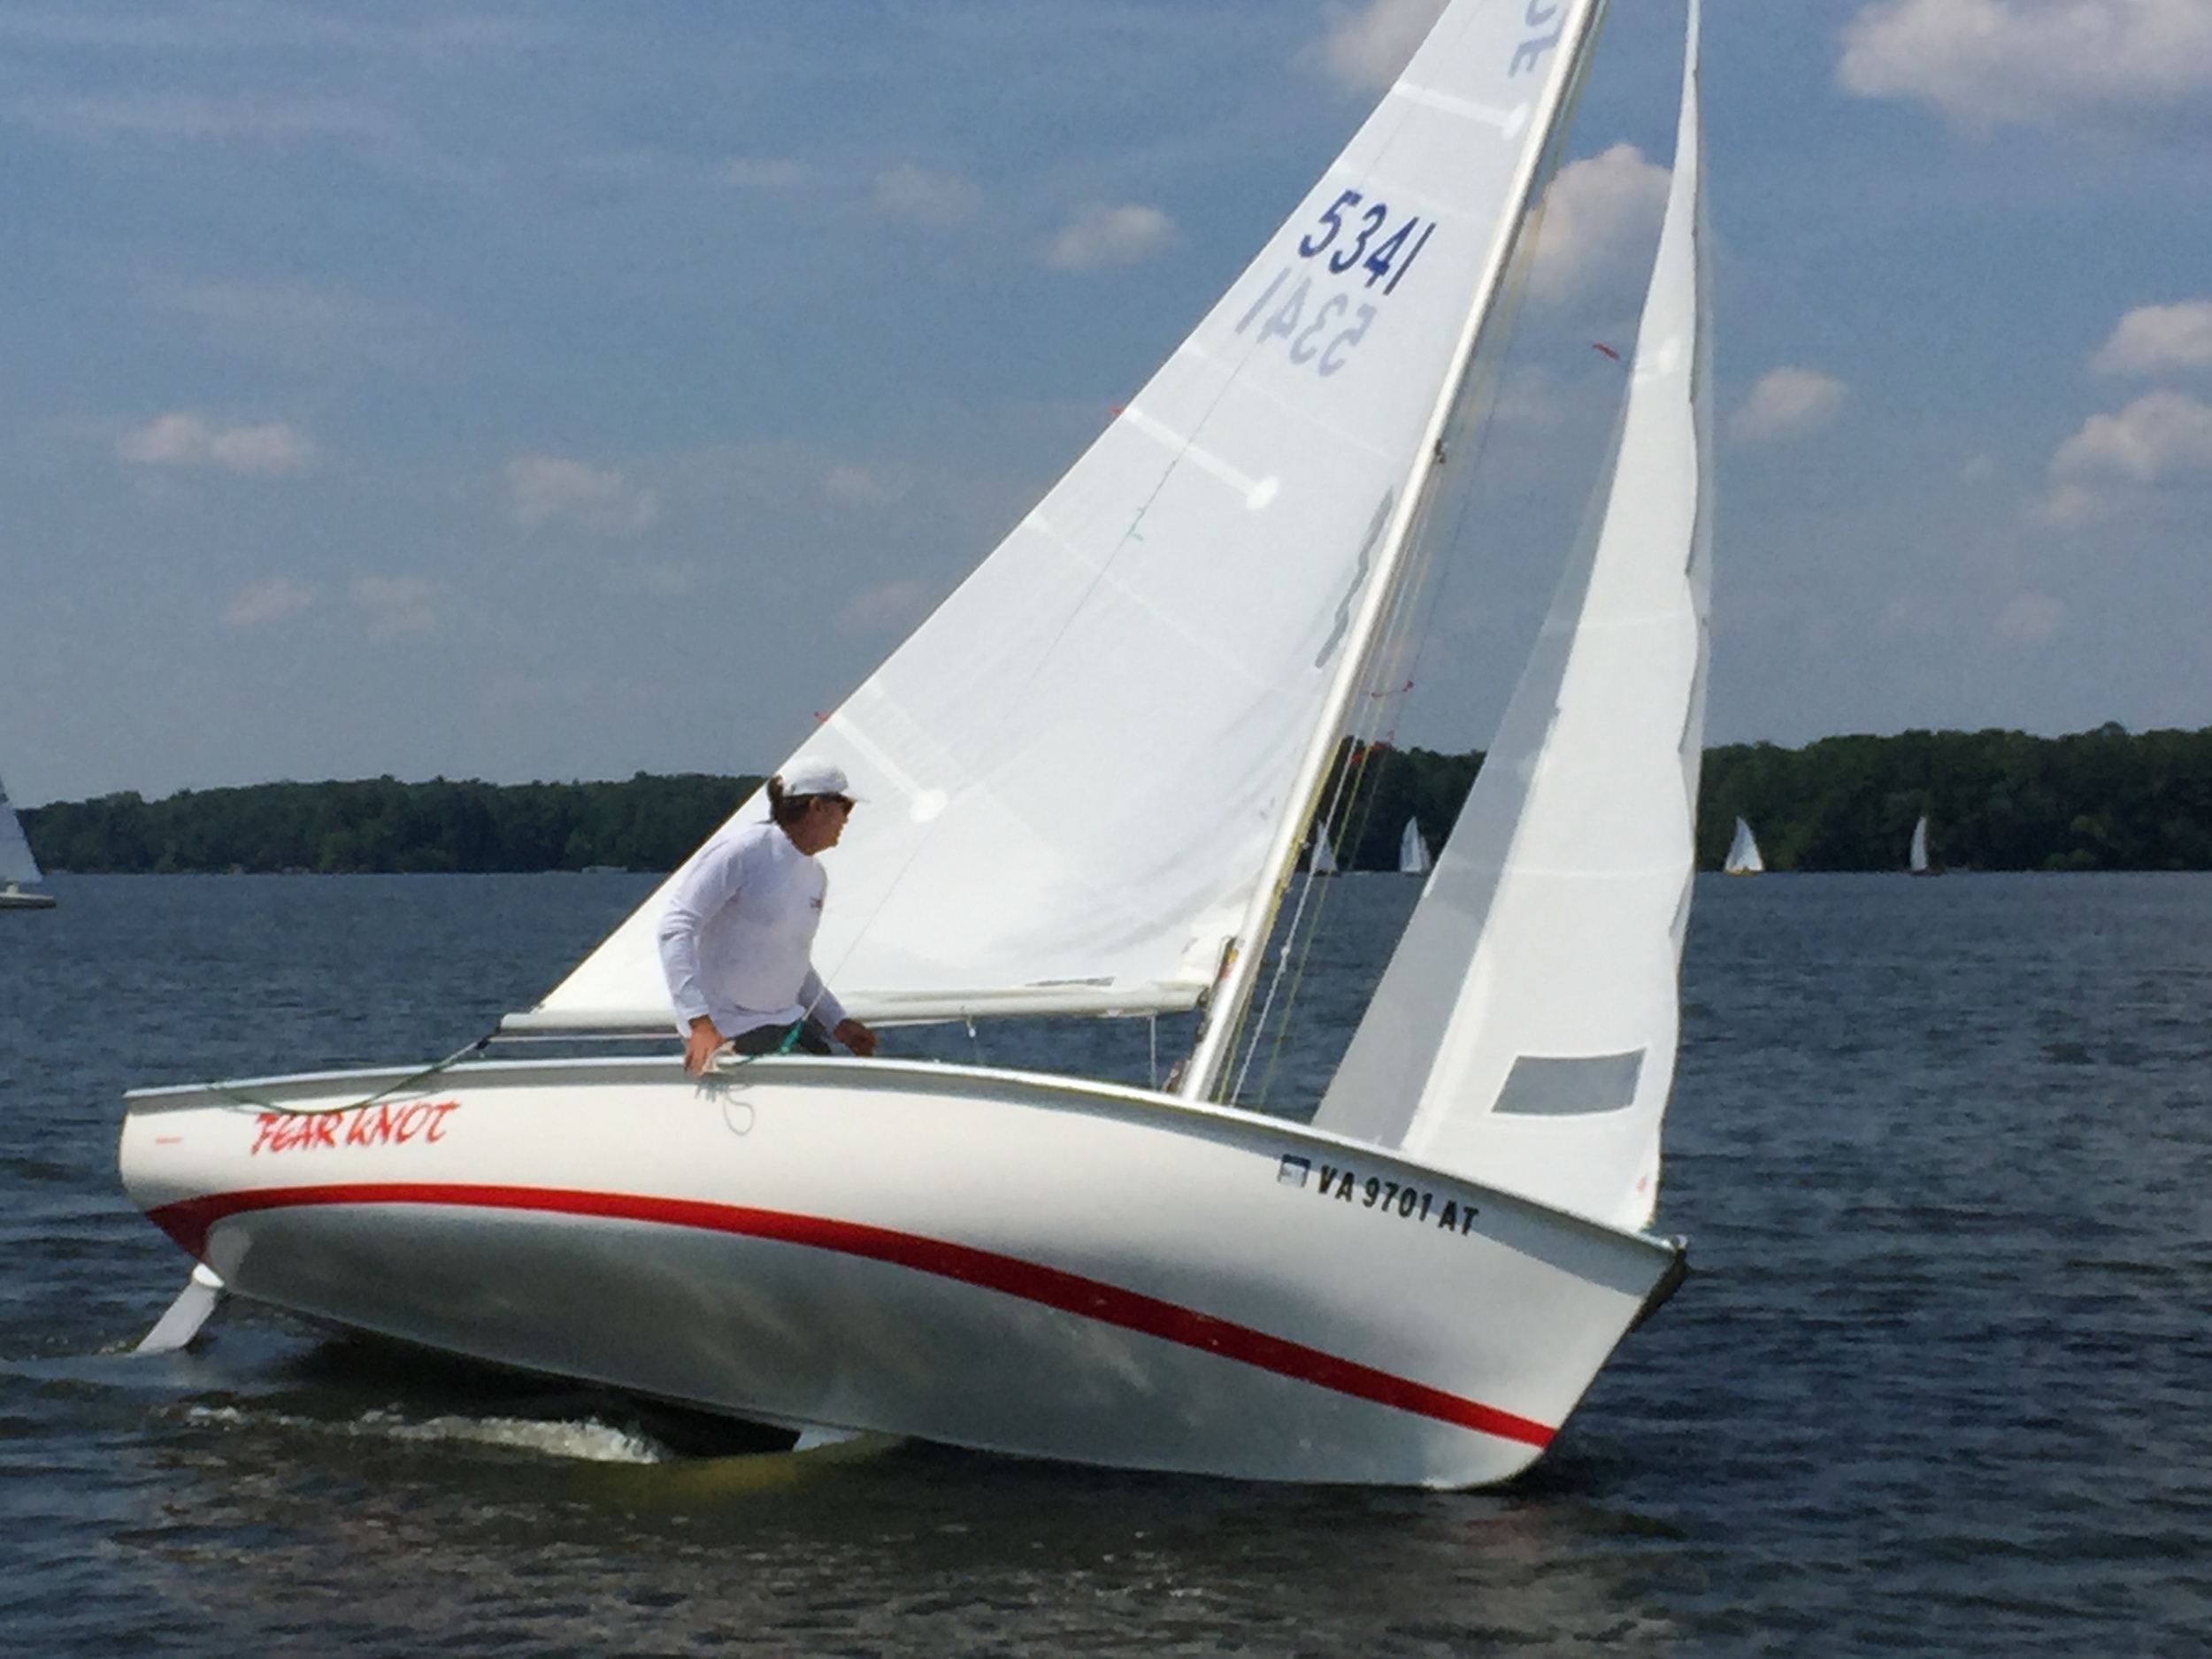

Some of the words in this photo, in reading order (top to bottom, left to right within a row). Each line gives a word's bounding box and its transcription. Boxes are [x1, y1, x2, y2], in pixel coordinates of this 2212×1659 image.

[1298, 189, 1437, 296] 5341
[250, 1110, 344, 1155] FEAR
[346, 1100, 461, 1145] KNOT
[1318, 1164, 1355, 1202] VA
[1362, 1177, 1433, 1222] 9701
[1437, 1200, 1480, 1237] AT
